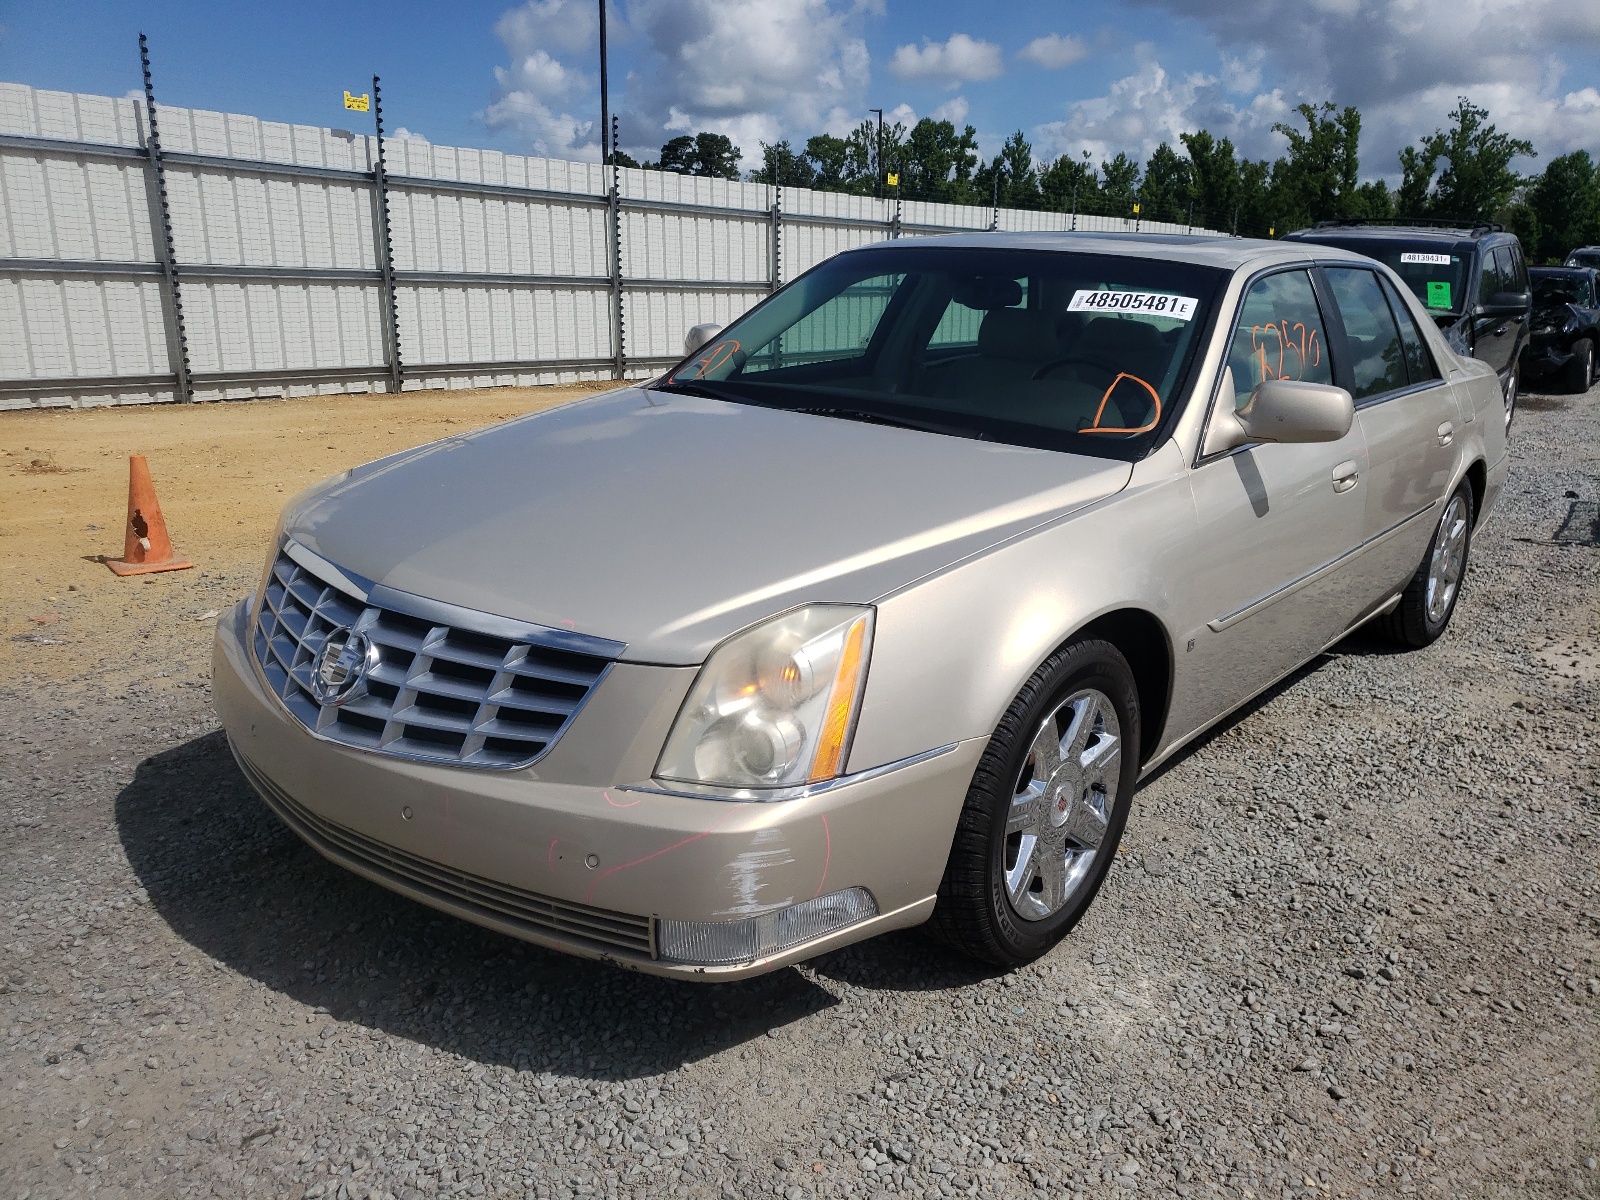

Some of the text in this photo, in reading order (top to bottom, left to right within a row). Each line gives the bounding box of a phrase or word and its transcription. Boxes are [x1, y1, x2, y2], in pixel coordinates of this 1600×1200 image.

[1406, 254, 1443, 262] 48139431
[1085, 292, 1179, 313] 48505481
[1180, 303, 1189, 313] E
